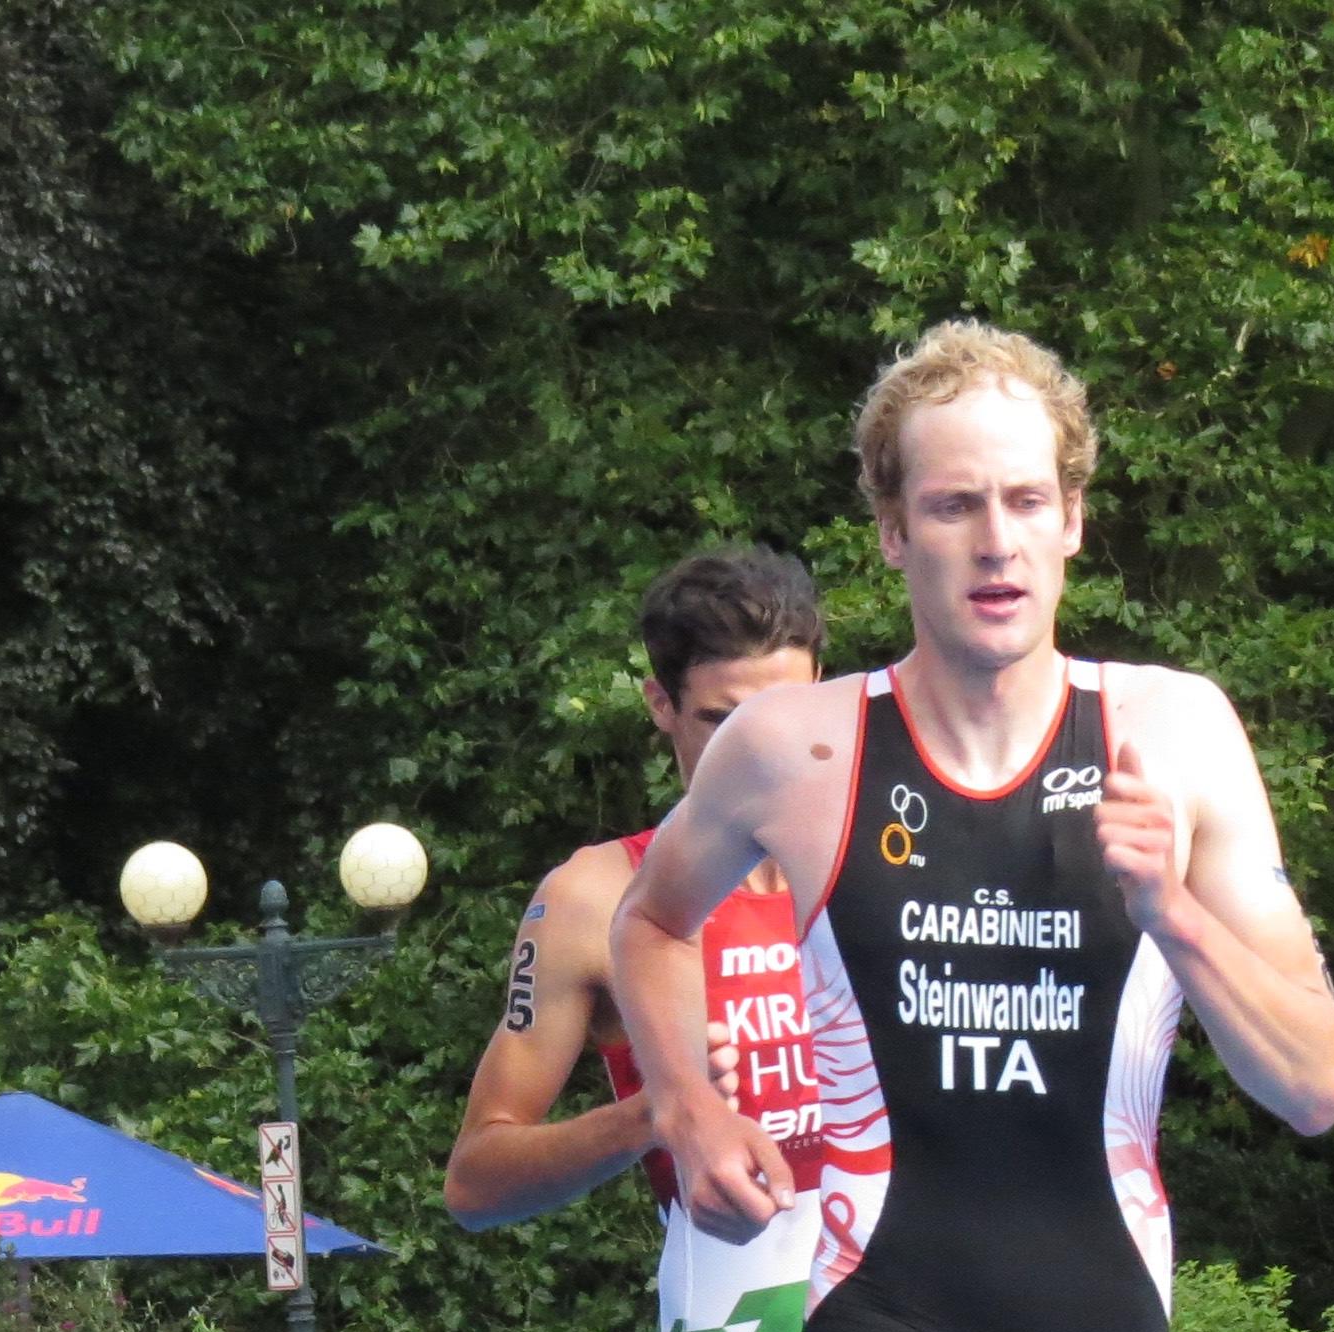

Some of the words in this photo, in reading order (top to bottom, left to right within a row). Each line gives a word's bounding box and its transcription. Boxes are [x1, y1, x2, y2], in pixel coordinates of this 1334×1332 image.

[901, 900, 1080, 949] CARABINIERI
[974, 888, 1014, 906] C.S.
[507, 940, 536, 1032] 25
[898, 959, 1085, 1031] Steinwandter
[941, 1034, 1048, 1095] ITA
